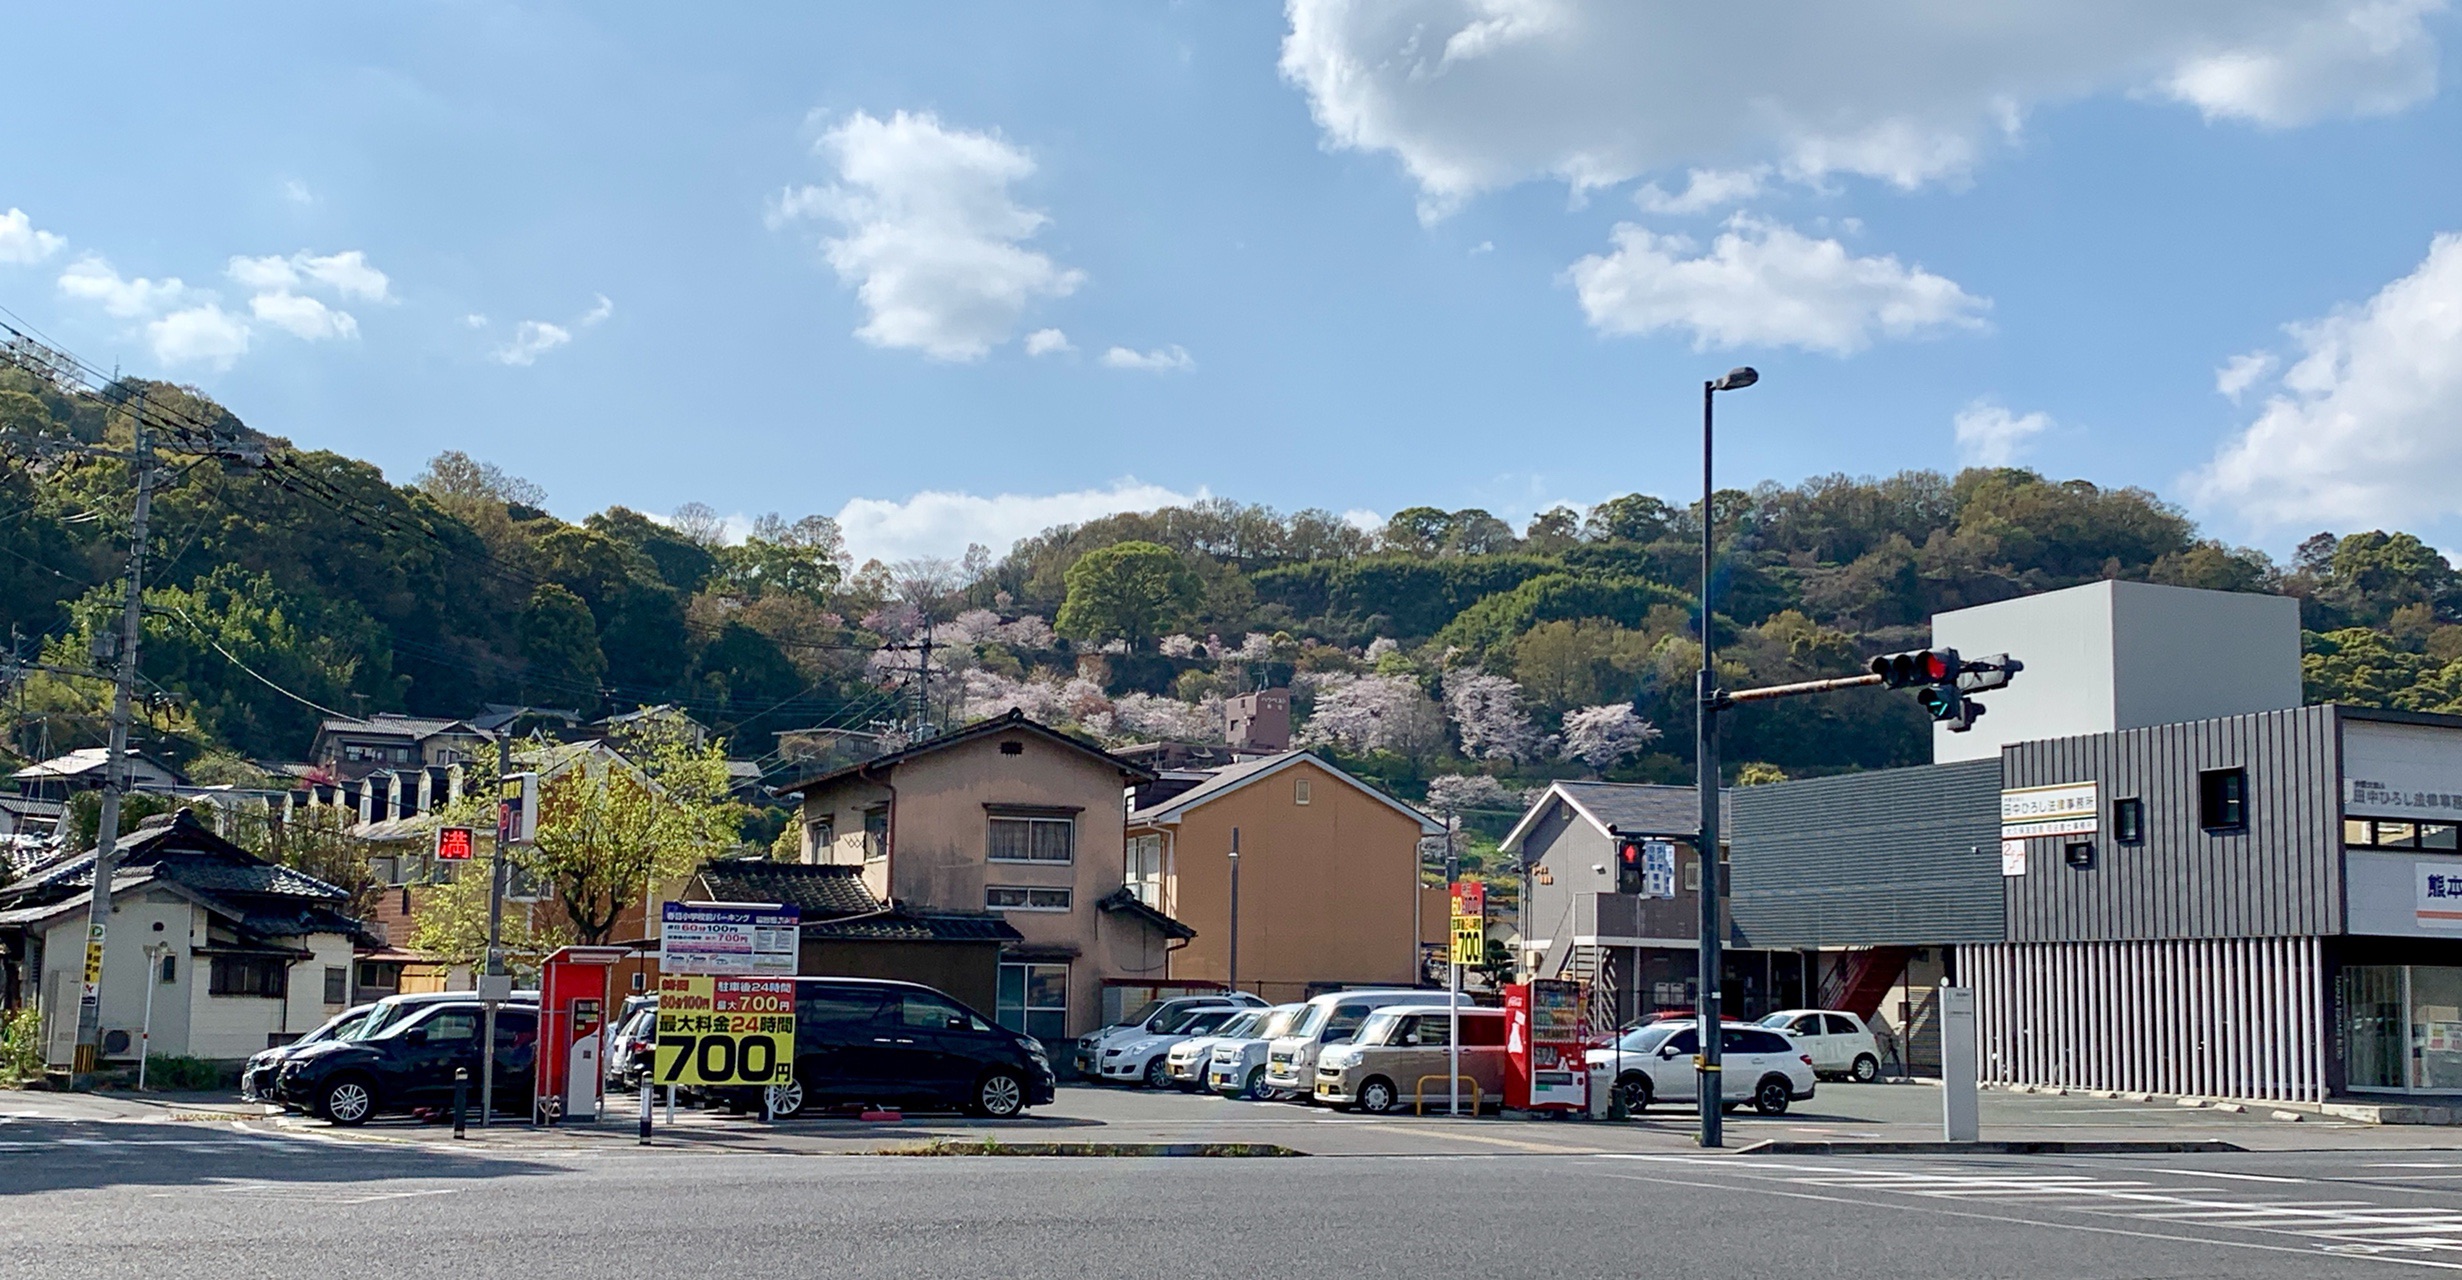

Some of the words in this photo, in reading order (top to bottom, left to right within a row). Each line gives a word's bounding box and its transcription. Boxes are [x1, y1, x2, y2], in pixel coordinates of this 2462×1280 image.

[2004, 796, 2093, 815] 田中ひろし法律事務所
[440, 830, 470, 859] 満
[2427, 873, 2462, 899] 熊本
[717, 981, 792, 994] 駐車後24時間
[716, 995, 790, 1012] 最大700円
[658, 1014, 794, 1034] 最大料金24時間
[656, 1034, 792, 1082] 700円
